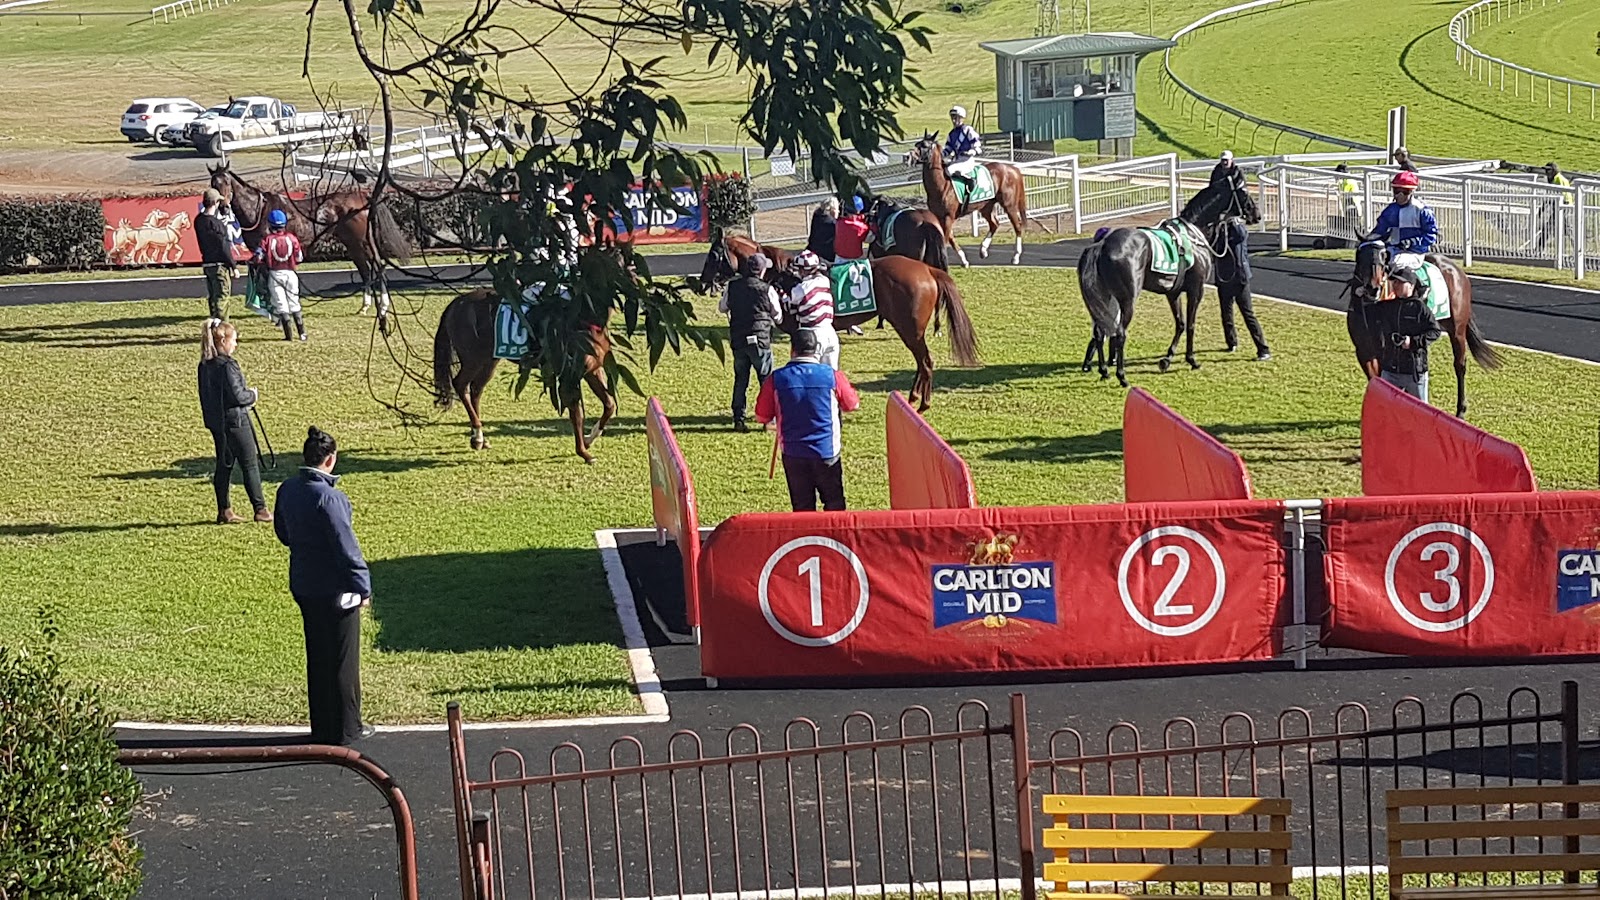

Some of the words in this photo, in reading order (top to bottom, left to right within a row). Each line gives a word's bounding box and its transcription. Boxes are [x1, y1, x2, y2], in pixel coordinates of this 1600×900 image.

[798, 556, 824, 627] 1
[933, 567, 1052, 592] CARLTON
[966, 592, 1022, 614] MID
[1151, 545, 1194, 616] 2
[1420, 541, 1461, 613] 3
